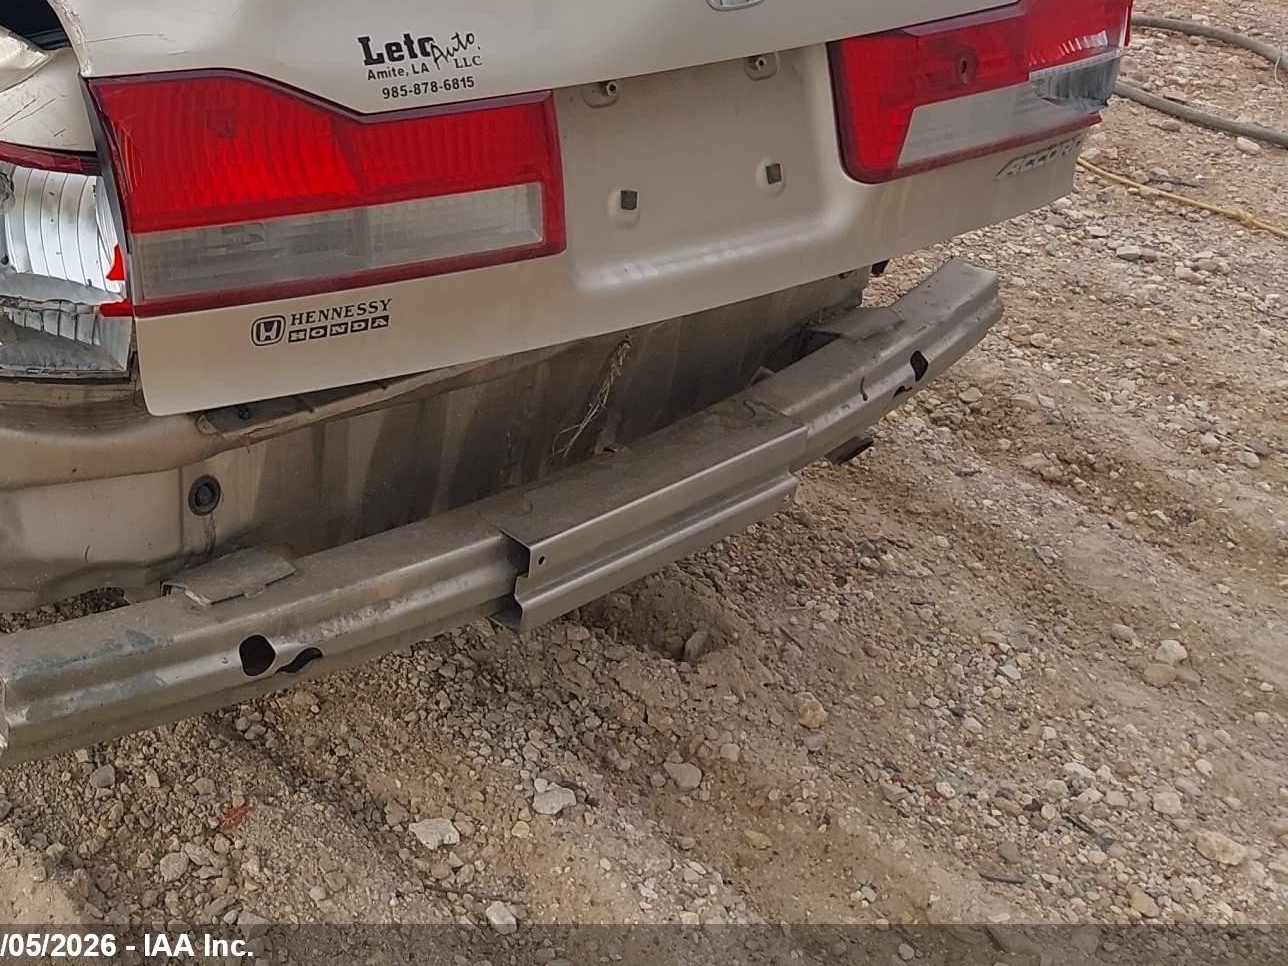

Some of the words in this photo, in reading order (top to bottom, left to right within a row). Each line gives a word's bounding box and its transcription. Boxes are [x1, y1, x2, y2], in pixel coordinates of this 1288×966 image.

[367, 66, 409, 81] Amite,
[411, 62, 430, 74] LA
[453, 56, 482, 68] LLC
[382, 76, 475, 99] 985-878-6815
[290, 298, 392, 326] HENNESSY
[288, 314, 389, 343] HONDA
